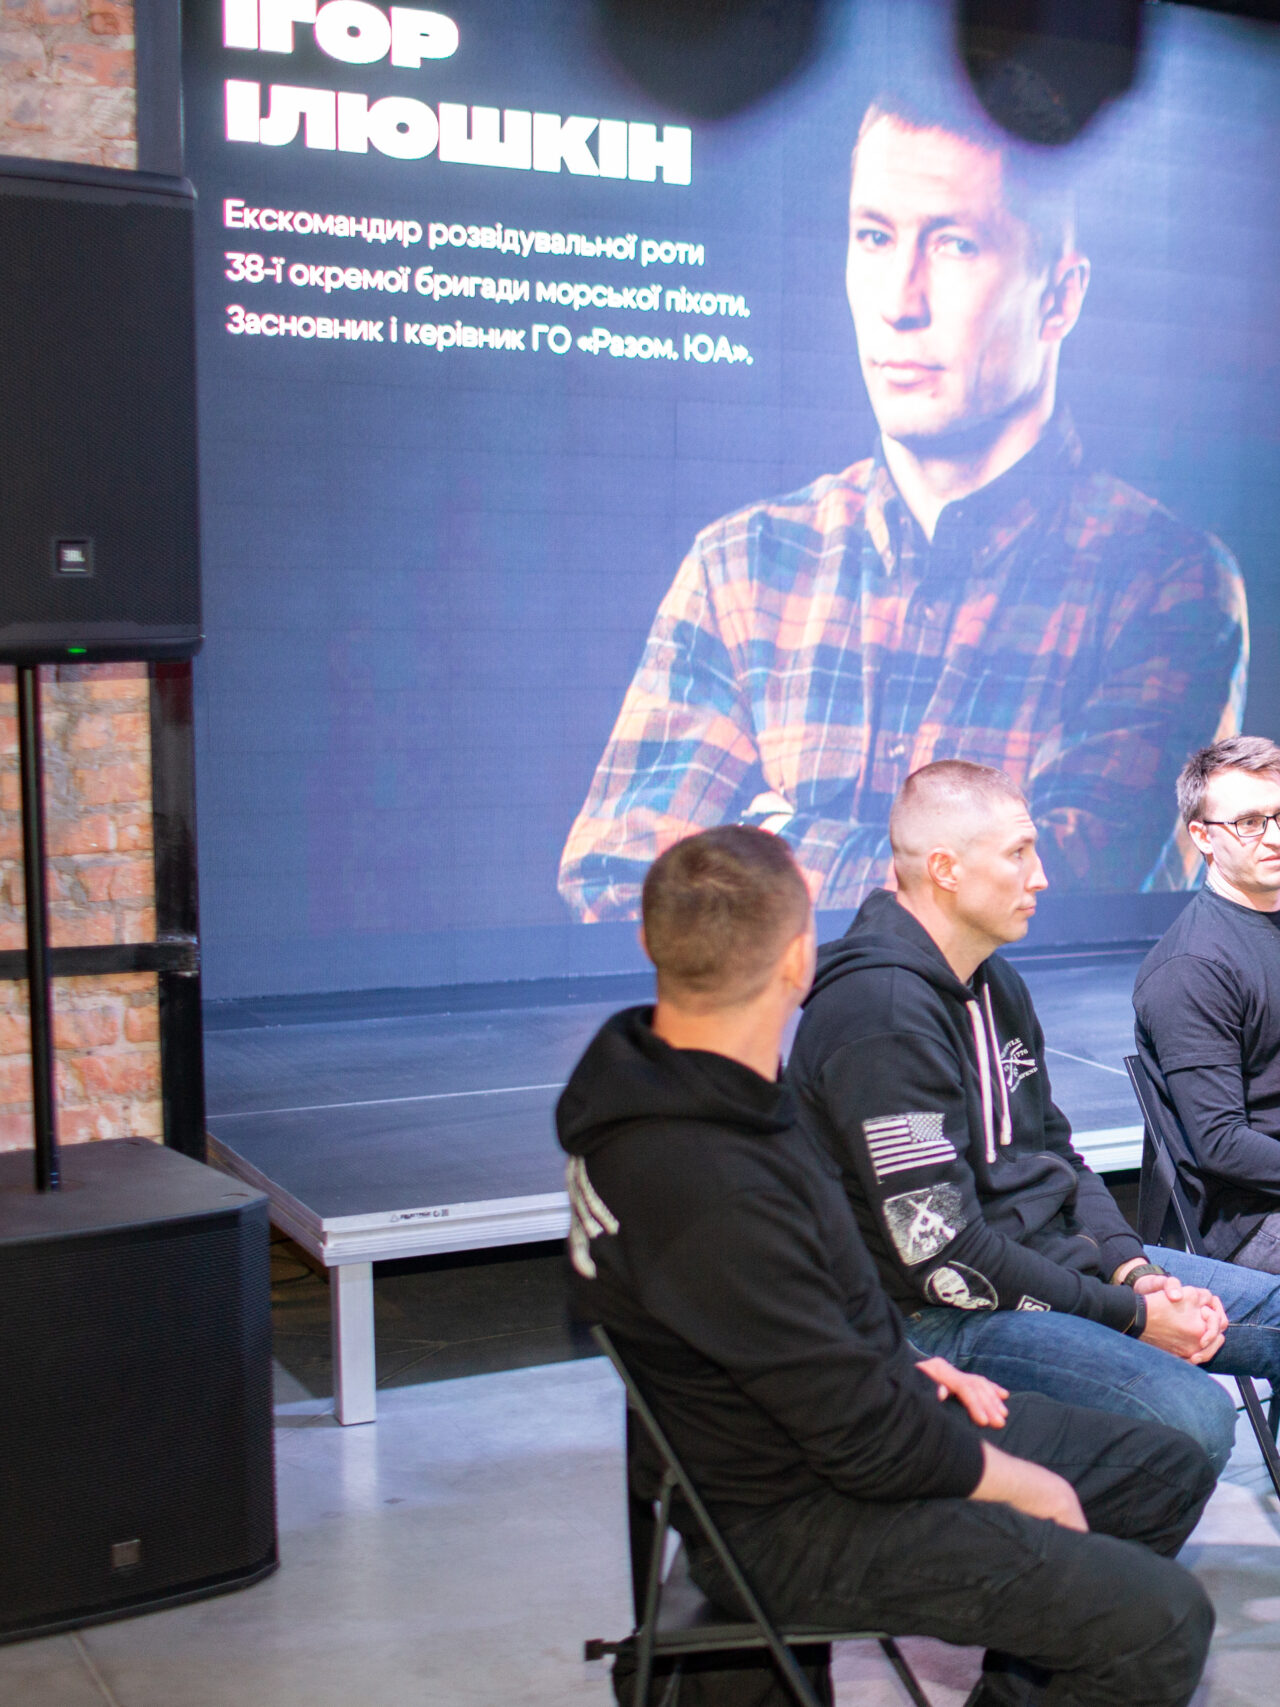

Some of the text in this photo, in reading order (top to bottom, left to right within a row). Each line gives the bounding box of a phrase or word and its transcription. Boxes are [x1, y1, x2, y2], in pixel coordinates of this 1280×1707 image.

[225, 0, 458, 68] ІГОР
[226, 80, 692, 185] ІЛЮШКІН
[225, 200, 705, 267] Екскомандир розвідувальної роти
[225, 252, 751, 318] 38-ї окремої бригади морської піхоти.
[227, 305, 384, 341] Засновник
[390, 316, 398, 343] і
[404, 320, 526, 352] керівник
[531, 324, 573, 354] ГО
